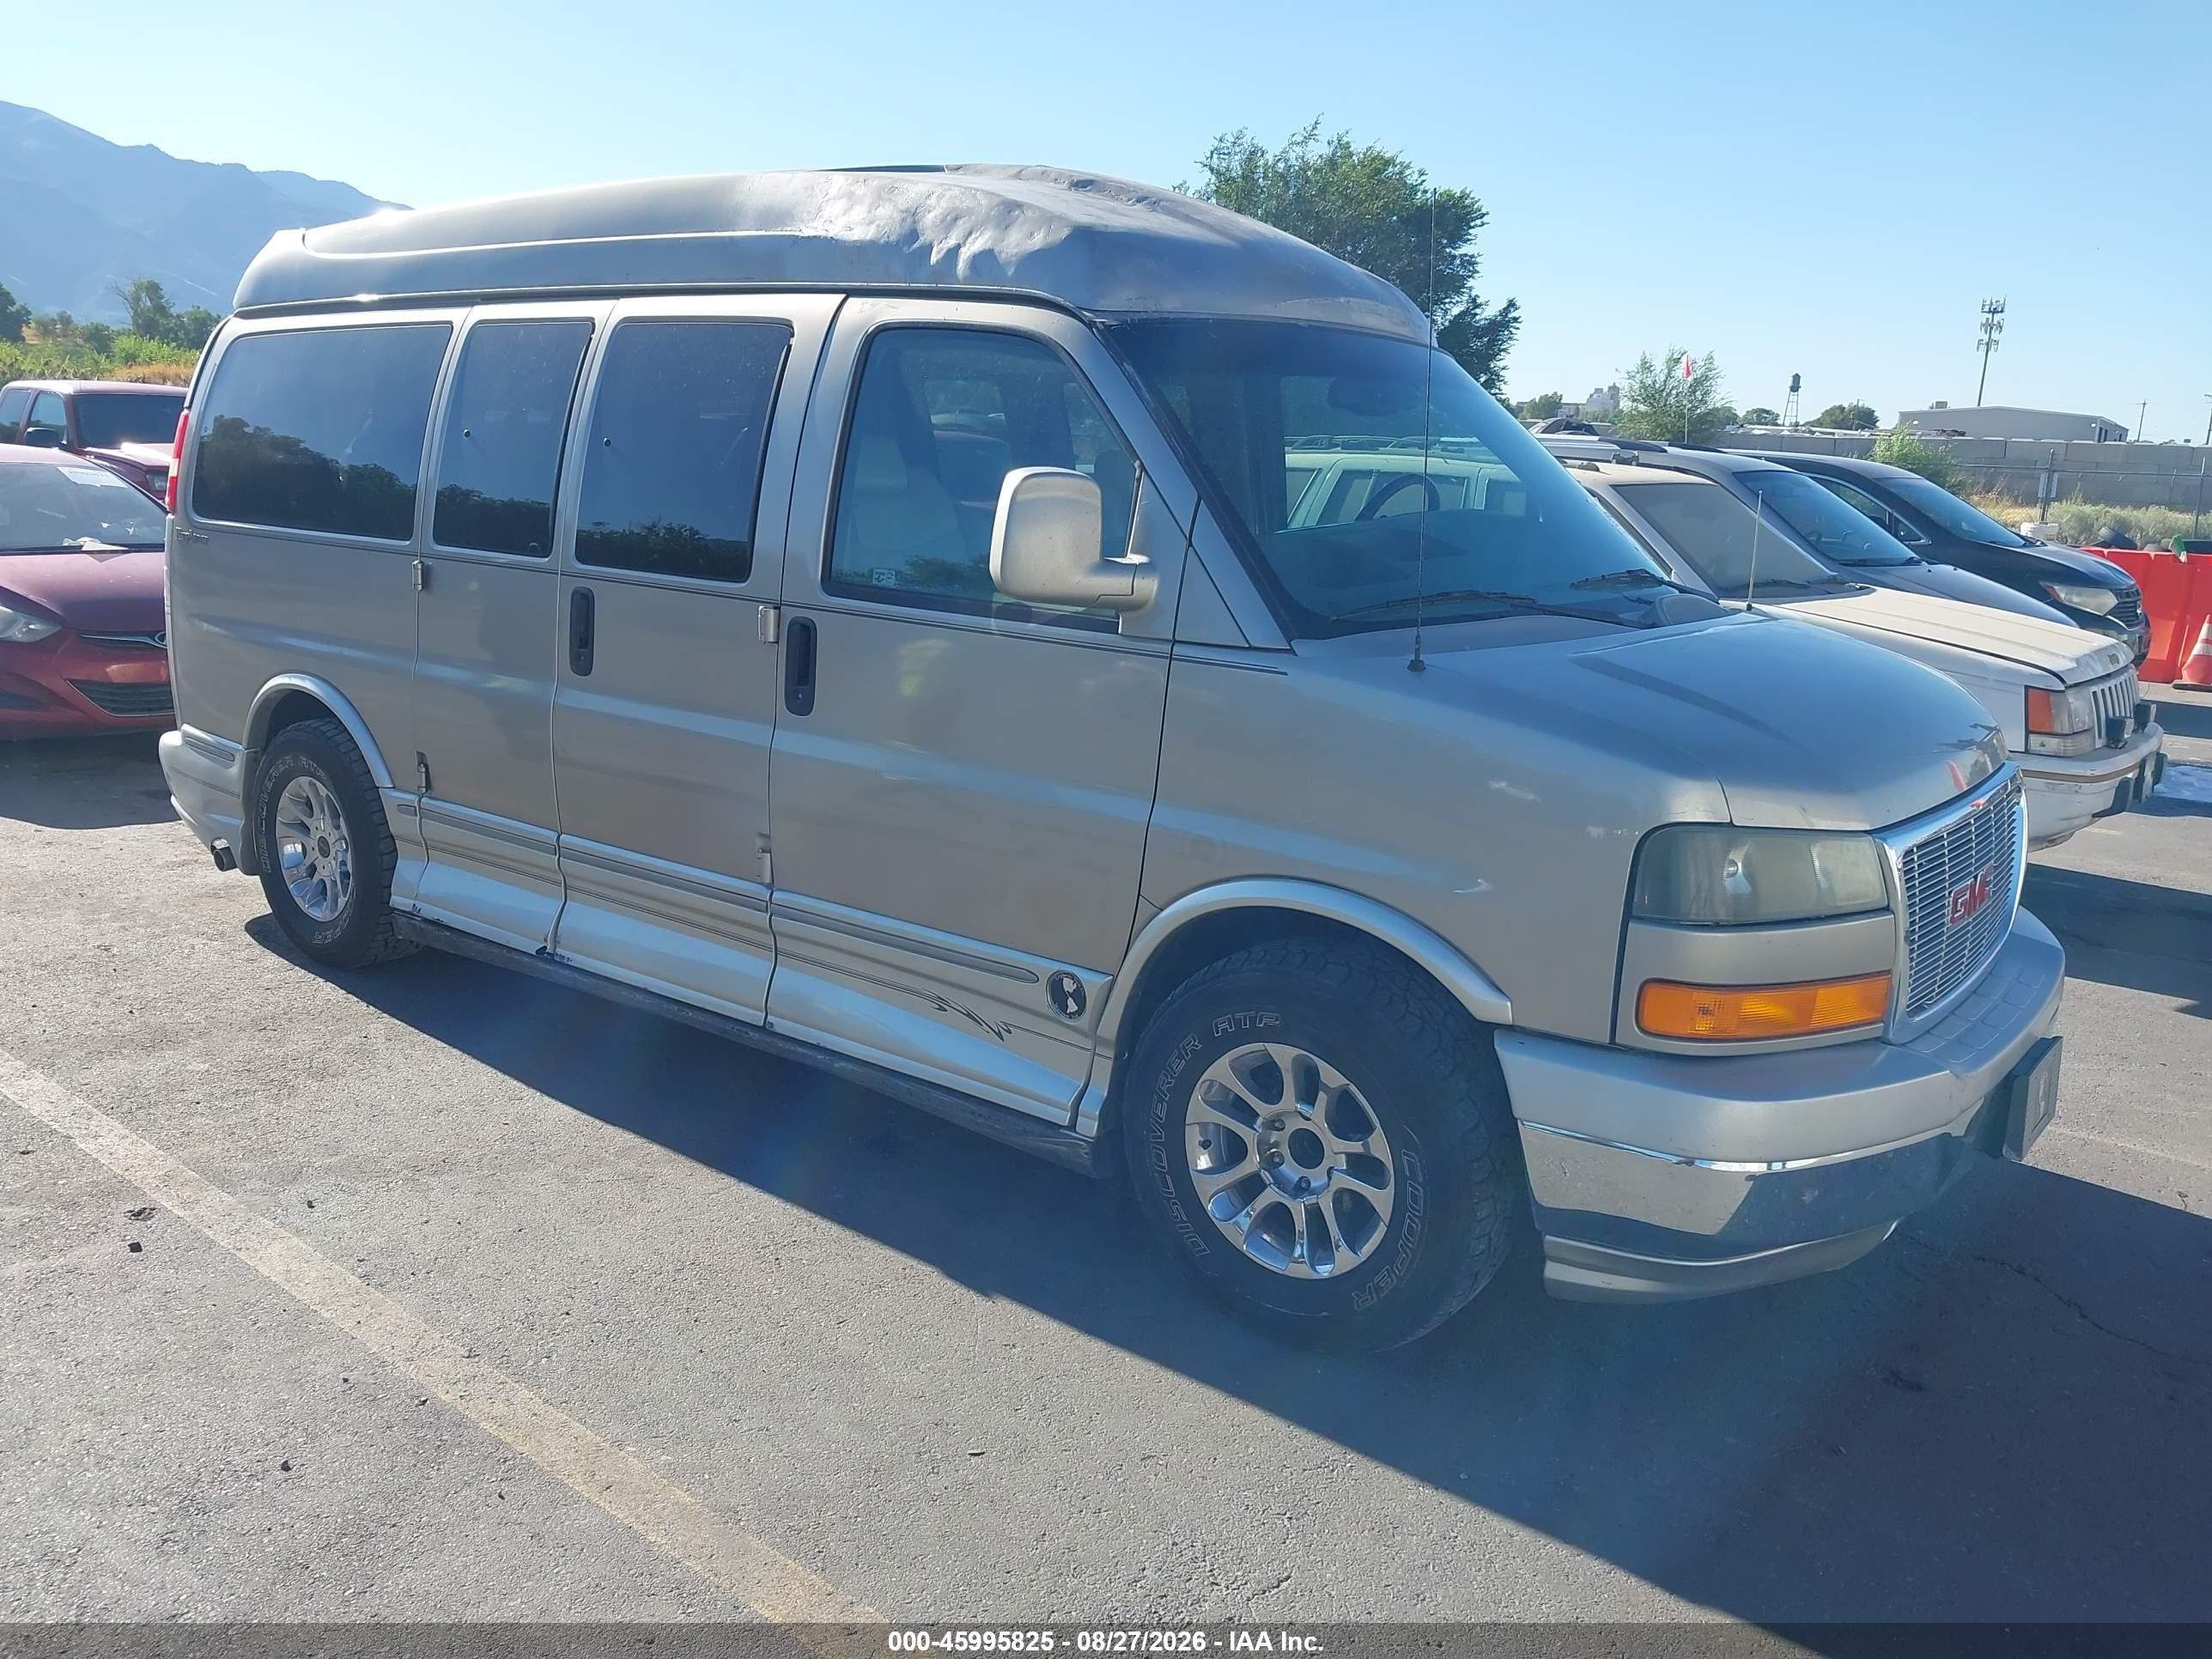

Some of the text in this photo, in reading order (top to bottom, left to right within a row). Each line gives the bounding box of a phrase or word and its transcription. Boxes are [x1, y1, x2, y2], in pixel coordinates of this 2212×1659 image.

[1949, 861, 1995, 925] GMC
[1148, 1033, 1210, 1257] DISCOVERER
[1351, 1148, 1425, 1311] COOPER
